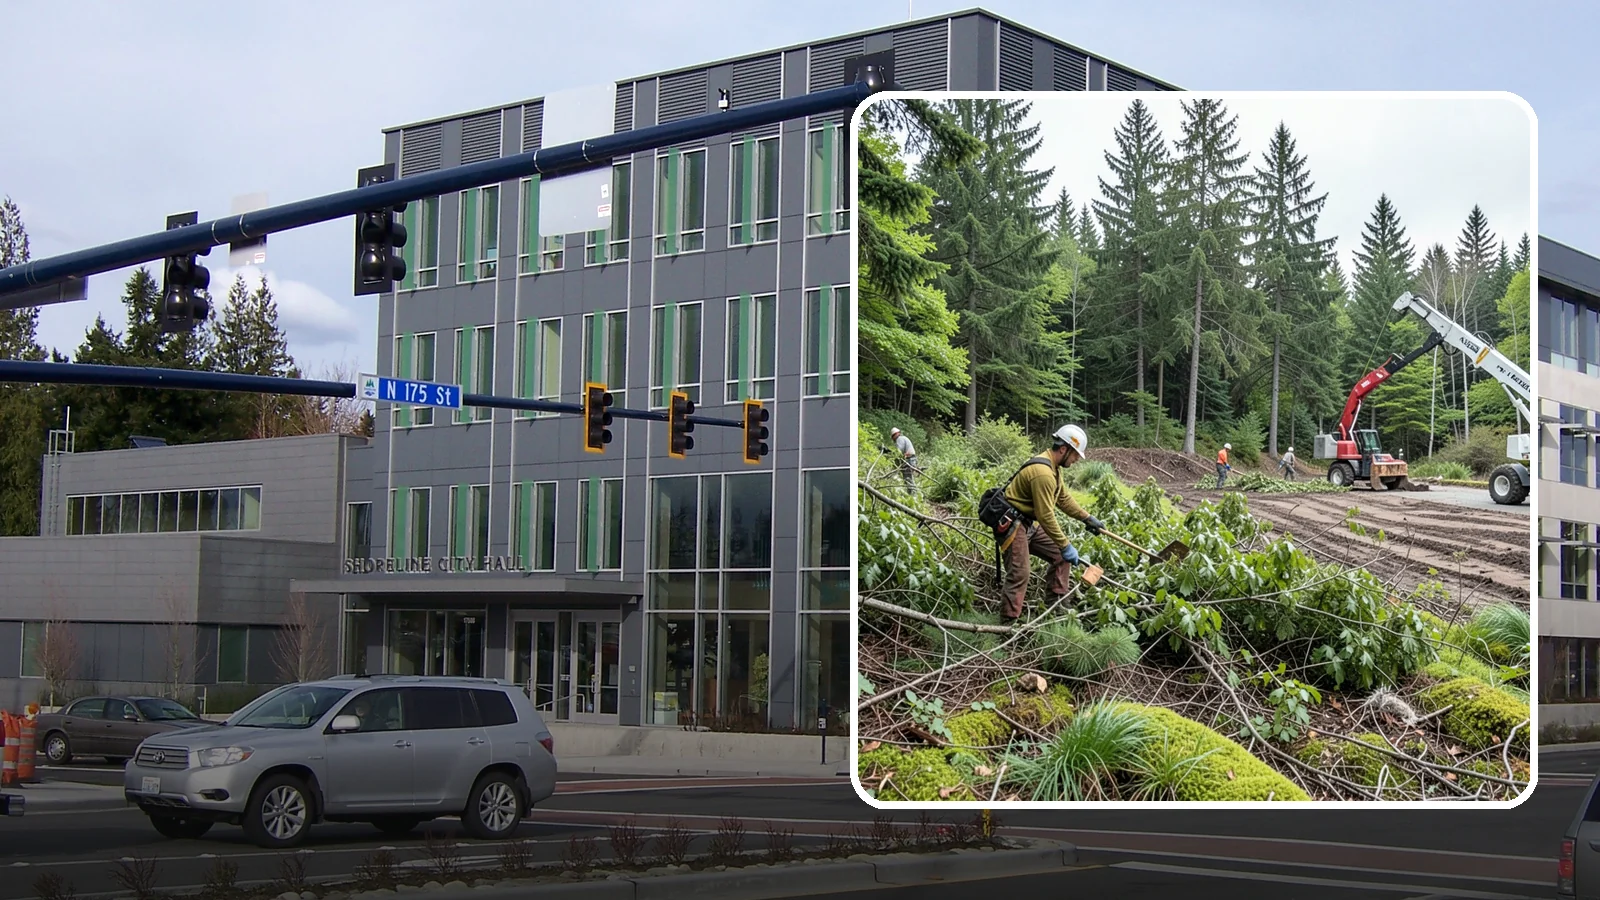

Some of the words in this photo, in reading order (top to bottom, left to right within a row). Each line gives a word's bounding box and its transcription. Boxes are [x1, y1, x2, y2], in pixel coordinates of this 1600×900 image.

[387, 380, 396, 400] N
[405, 382, 428, 403] 175
[436, 386, 451, 406] St
[344, 557, 432, 574] SHORELINE
[438, 556, 475, 572] CITY
[484, 555, 525, 572] HALL
